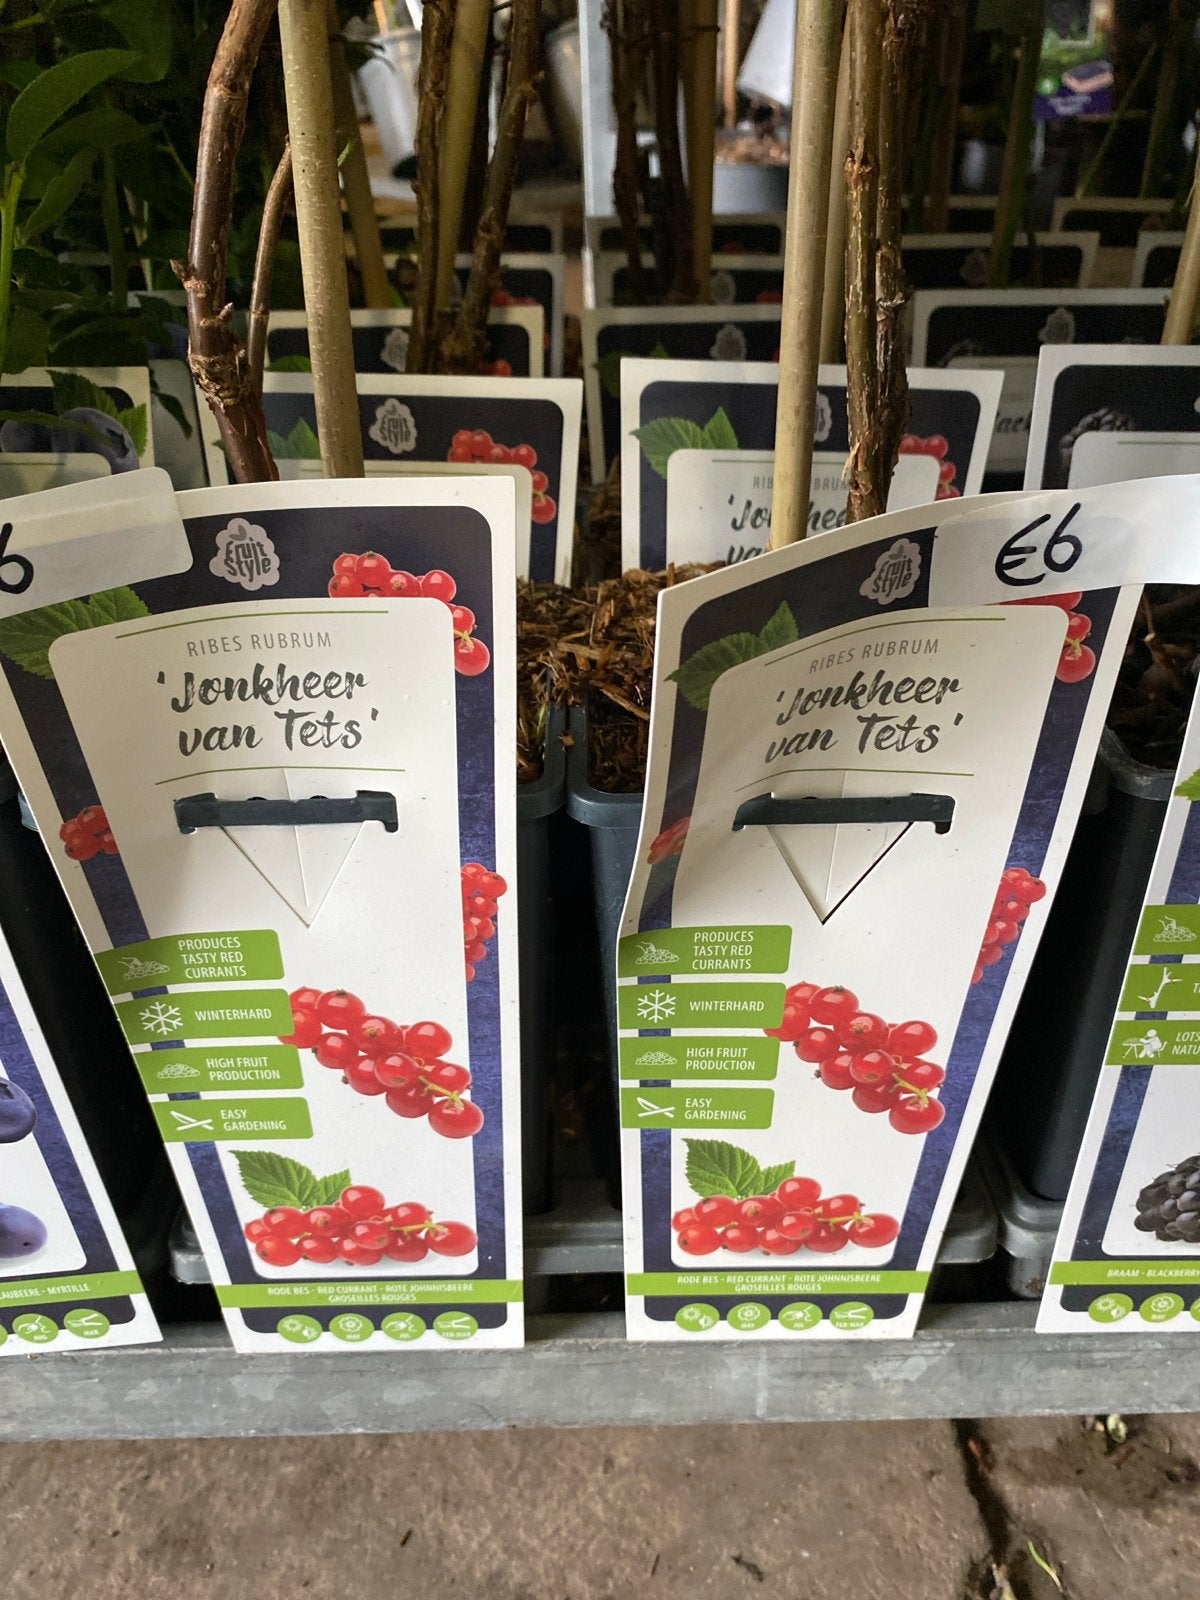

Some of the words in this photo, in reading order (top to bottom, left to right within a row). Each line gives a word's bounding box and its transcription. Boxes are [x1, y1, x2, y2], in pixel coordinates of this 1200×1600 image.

[995, 502, 1083, 587] €6
[187, 635, 243, 657] RIBES
[250, 631, 333, 649] RUBRUM
[809, 647, 856, 674] RIBES
[862, 638, 939, 659] RUBRUM
[178, 724, 264, 757] van
[764, 728, 838, 764] van
[693, 930, 755, 943] PRODUCES
[178, 936, 241, 951] PRODUCES
[693, 945, 727, 957] TASTY
[730, 944, 753, 956] RED
[181, 952, 218, 965] TASTY
[221, 951, 243, 964] RED
[692, 958, 752, 971] CURRANTS
[185, 965, 247, 979] CURRANTS
[689, 1000, 765, 1012] WINTERHARD
[194, 1008, 272, 1022] WINTERHARD
[686, 1047, 714, 1058] HIGH
[716, 1047, 748, 1058] FRUIT
[206, 1057, 235, 1069] HIGH
[236, 1056, 268, 1068] FRUIT
[685, 1060, 756, 1071] PRODUCTION
[209, 1069, 281, 1081] PRODUCTION
[685, 1097, 713, 1108] EASY
[220, 1108, 248, 1119] EASY
[684, 1110, 747, 1121] GARDENING
[223, 1120, 287, 1132] GARDENING
[677, 1275, 700, 1284] RODE
[702, 1275, 719, 1284] BES
[726, 1274, 744, 1283] RED
[745, 1274, 787, 1283] CURRANT
[794, 1274, 816, 1283] ROTE
[818, 1273, 881, 1283] JOHNNISBEERE
[1107, 1268, 1140, 1278] BRAAM
[46, 1283, 91, 1295] MYRTILLE
[267, 1286, 291, 1295] RODE
[293, 1286, 310, 1295] BES
[317, 1285, 335, 1294] RED
[336, 1284, 378, 1294] CURRANT
[385, 1284, 409, 1293] ROTE
[735, 1283, 786, 1292] GROSEILLES
[787, 1283, 822, 1291] ROUGES
[328, 1293, 380, 1303] GROSEILLES
[381, 1292, 417, 1301] ROUGES
